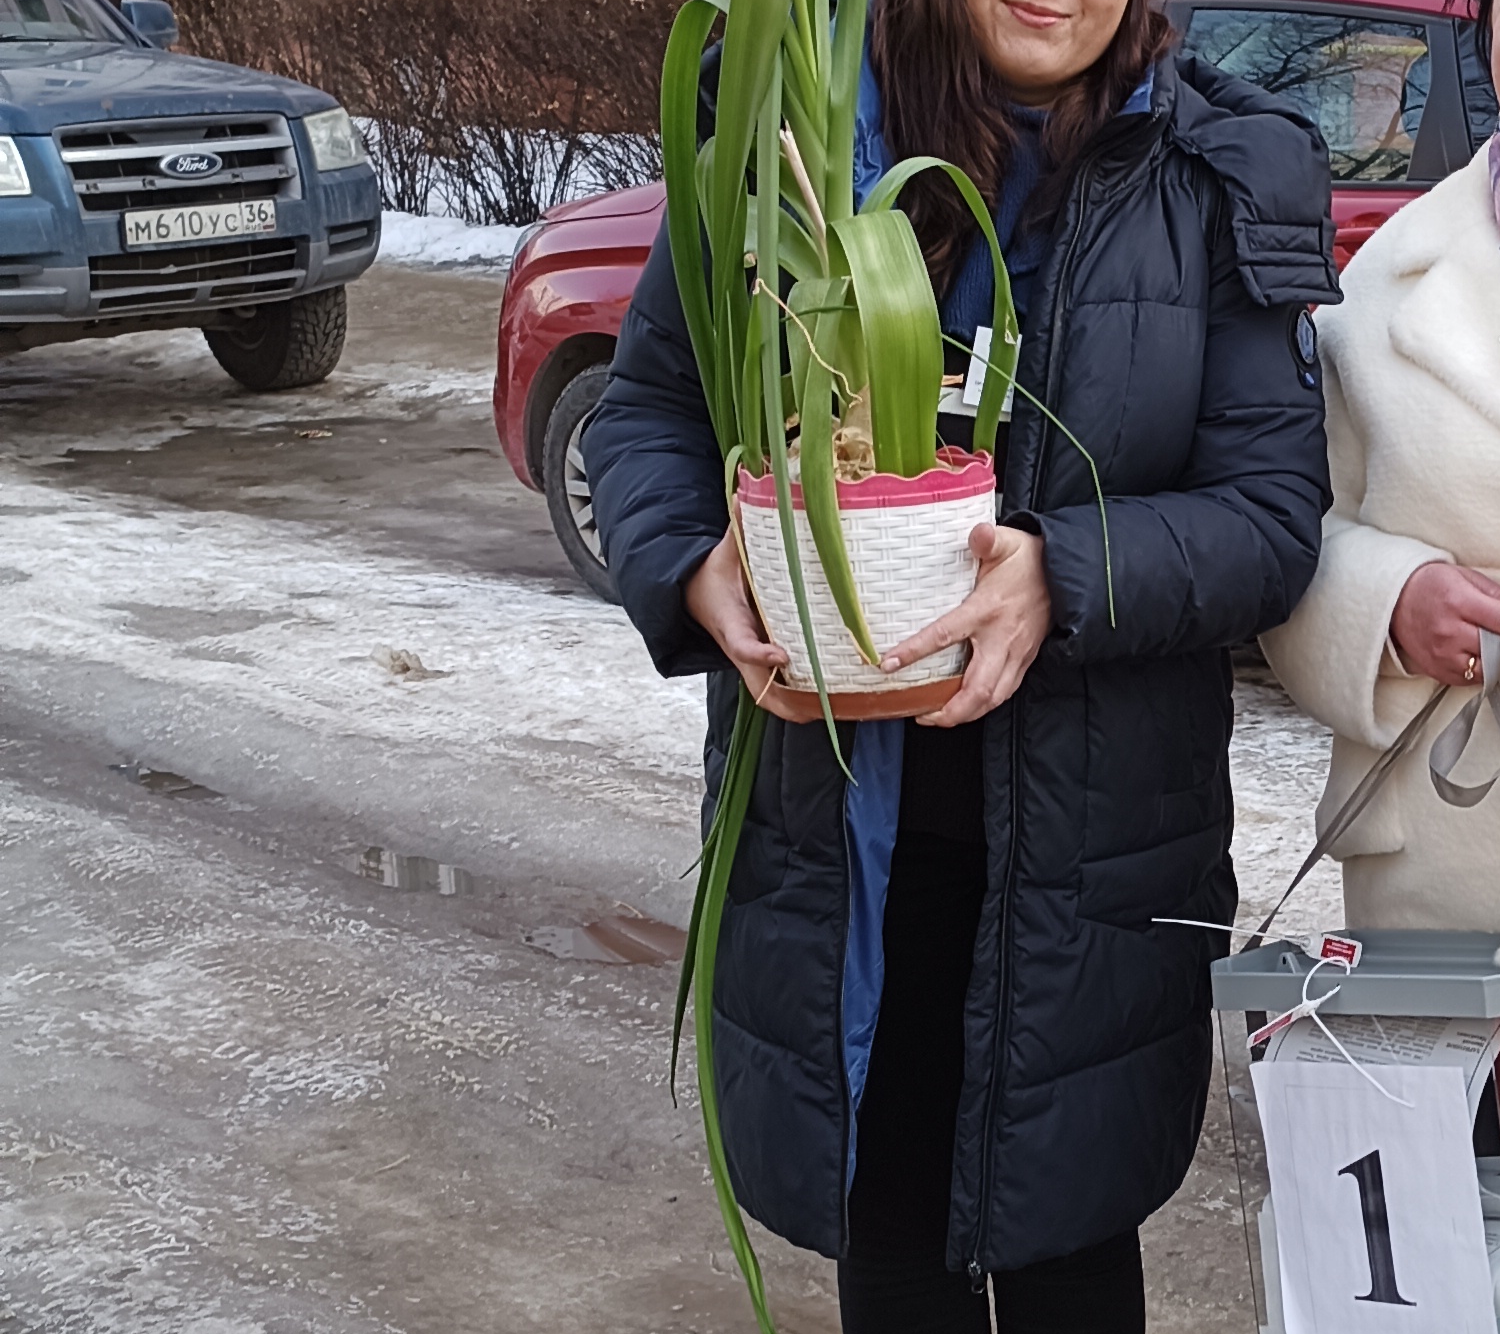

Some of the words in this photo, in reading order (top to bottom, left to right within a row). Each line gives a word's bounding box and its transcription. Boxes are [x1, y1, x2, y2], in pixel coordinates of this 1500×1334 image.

[176, 156, 209, 172] Ford
[135, 210, 239, 242] М610УС
[244, 202, 269, 223] 36
[244, 223, 262, 232] RUS
[1337, 1149, 1417, 1307] 1
